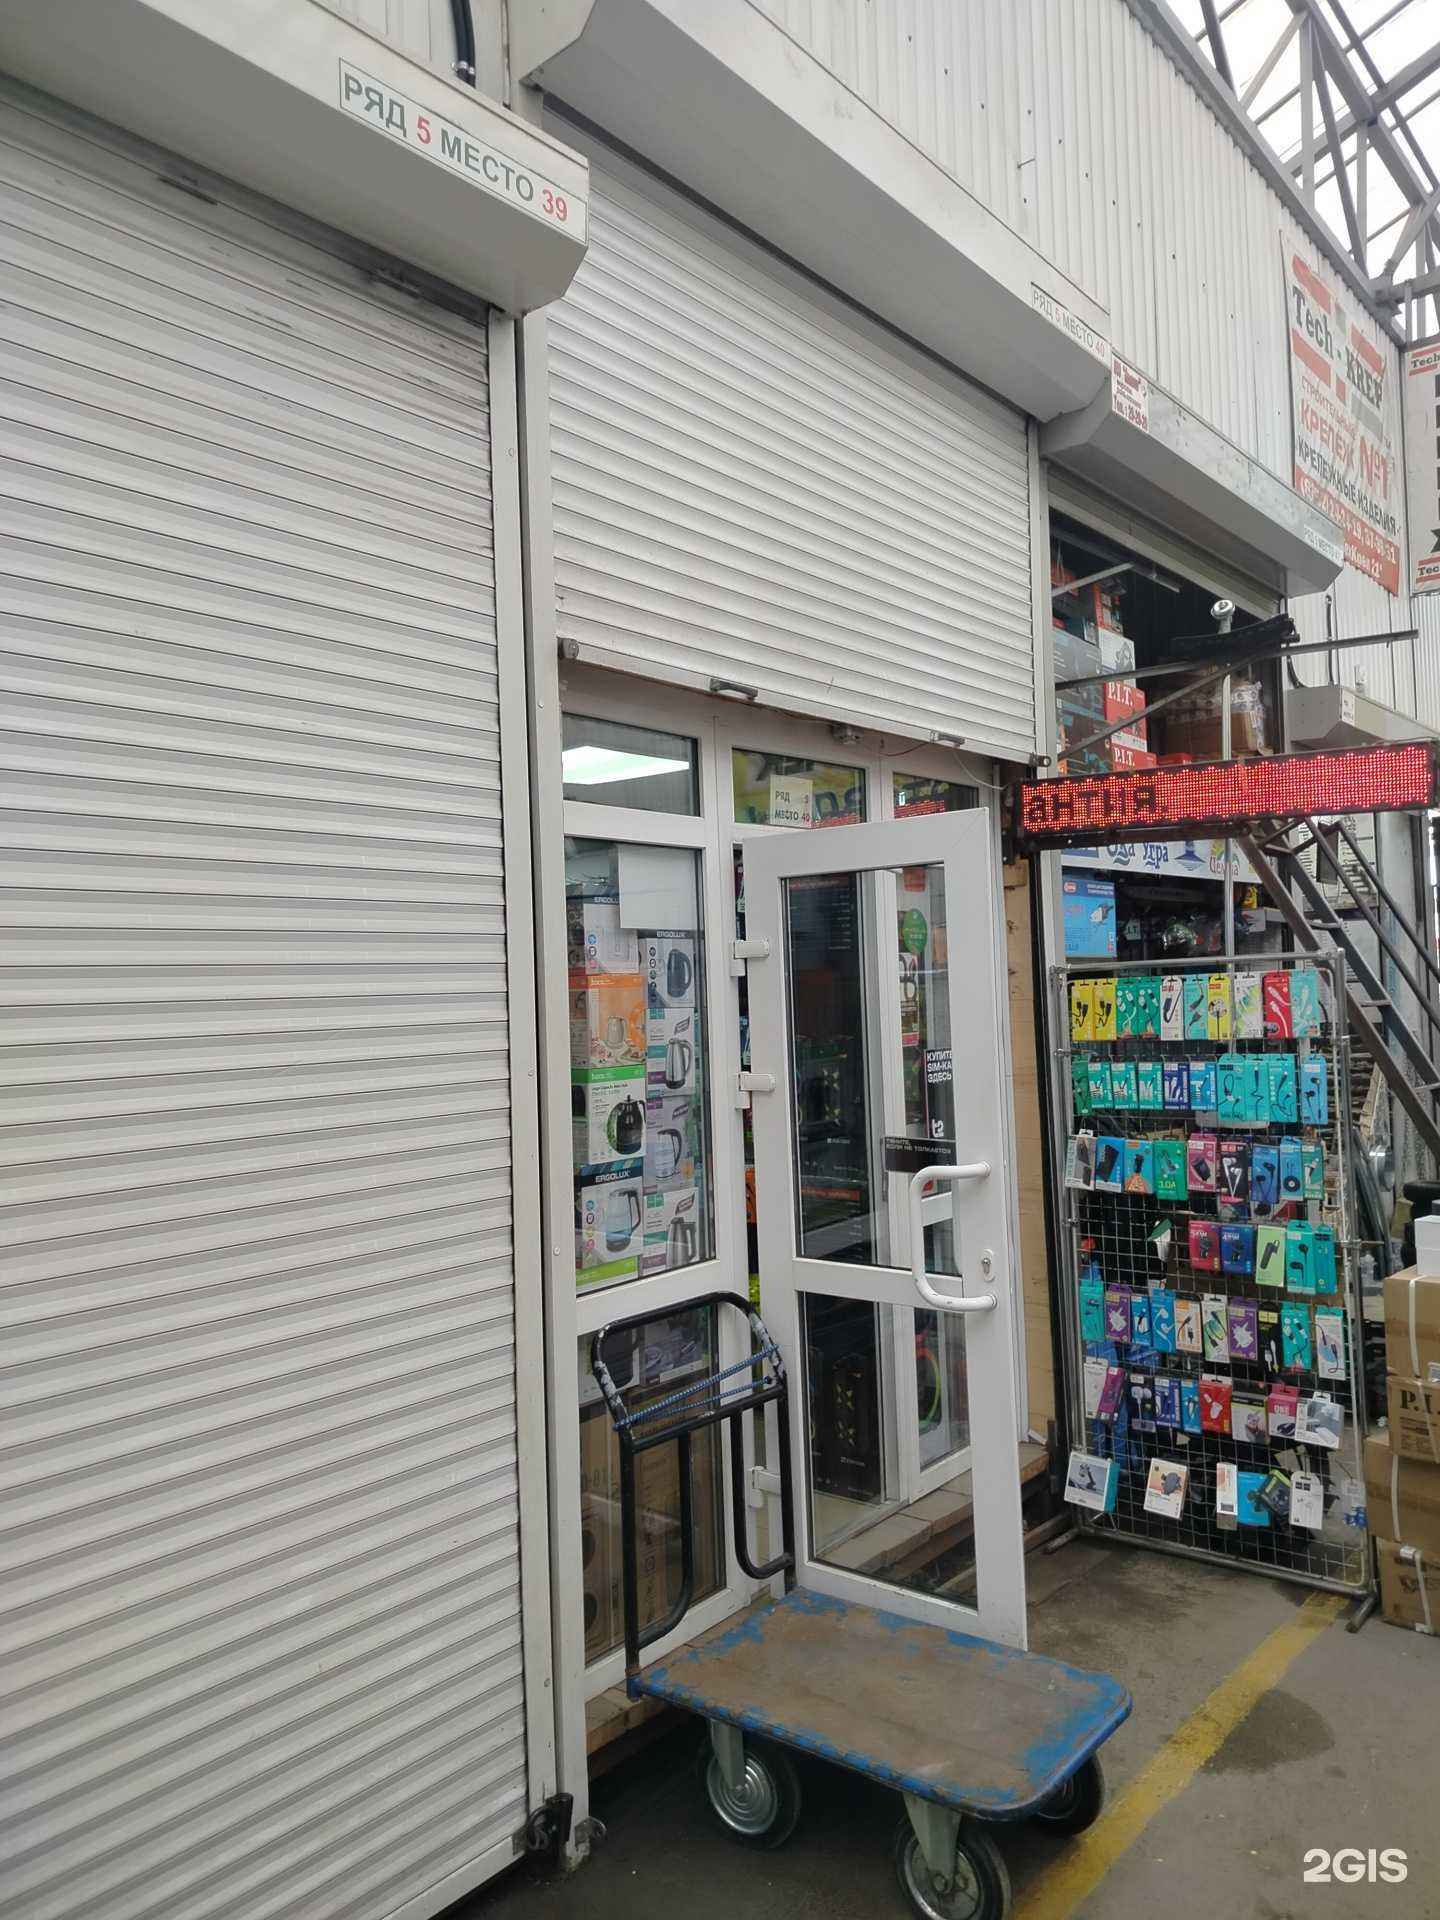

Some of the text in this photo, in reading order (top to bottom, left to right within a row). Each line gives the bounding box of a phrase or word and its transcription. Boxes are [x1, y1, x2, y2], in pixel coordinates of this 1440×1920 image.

[344, 72, 569, 223] РЯД 5 МЕСТО 39
[1033, 290, 1054, 321] РЯД
[1062, 313, 1095, 349] МЕСТО
[1114, 747, 1136, 767] P.I.T.
[775, 790, 791, 803] РЯД
[774, 809, 799, 821] МЕСТО
[656, 929, 687, 938] ERGOLUX
[927, 1072, 952, 1084] ЗДЕСЬ
[595, 1170, 629, 1183] ERGOLUX
